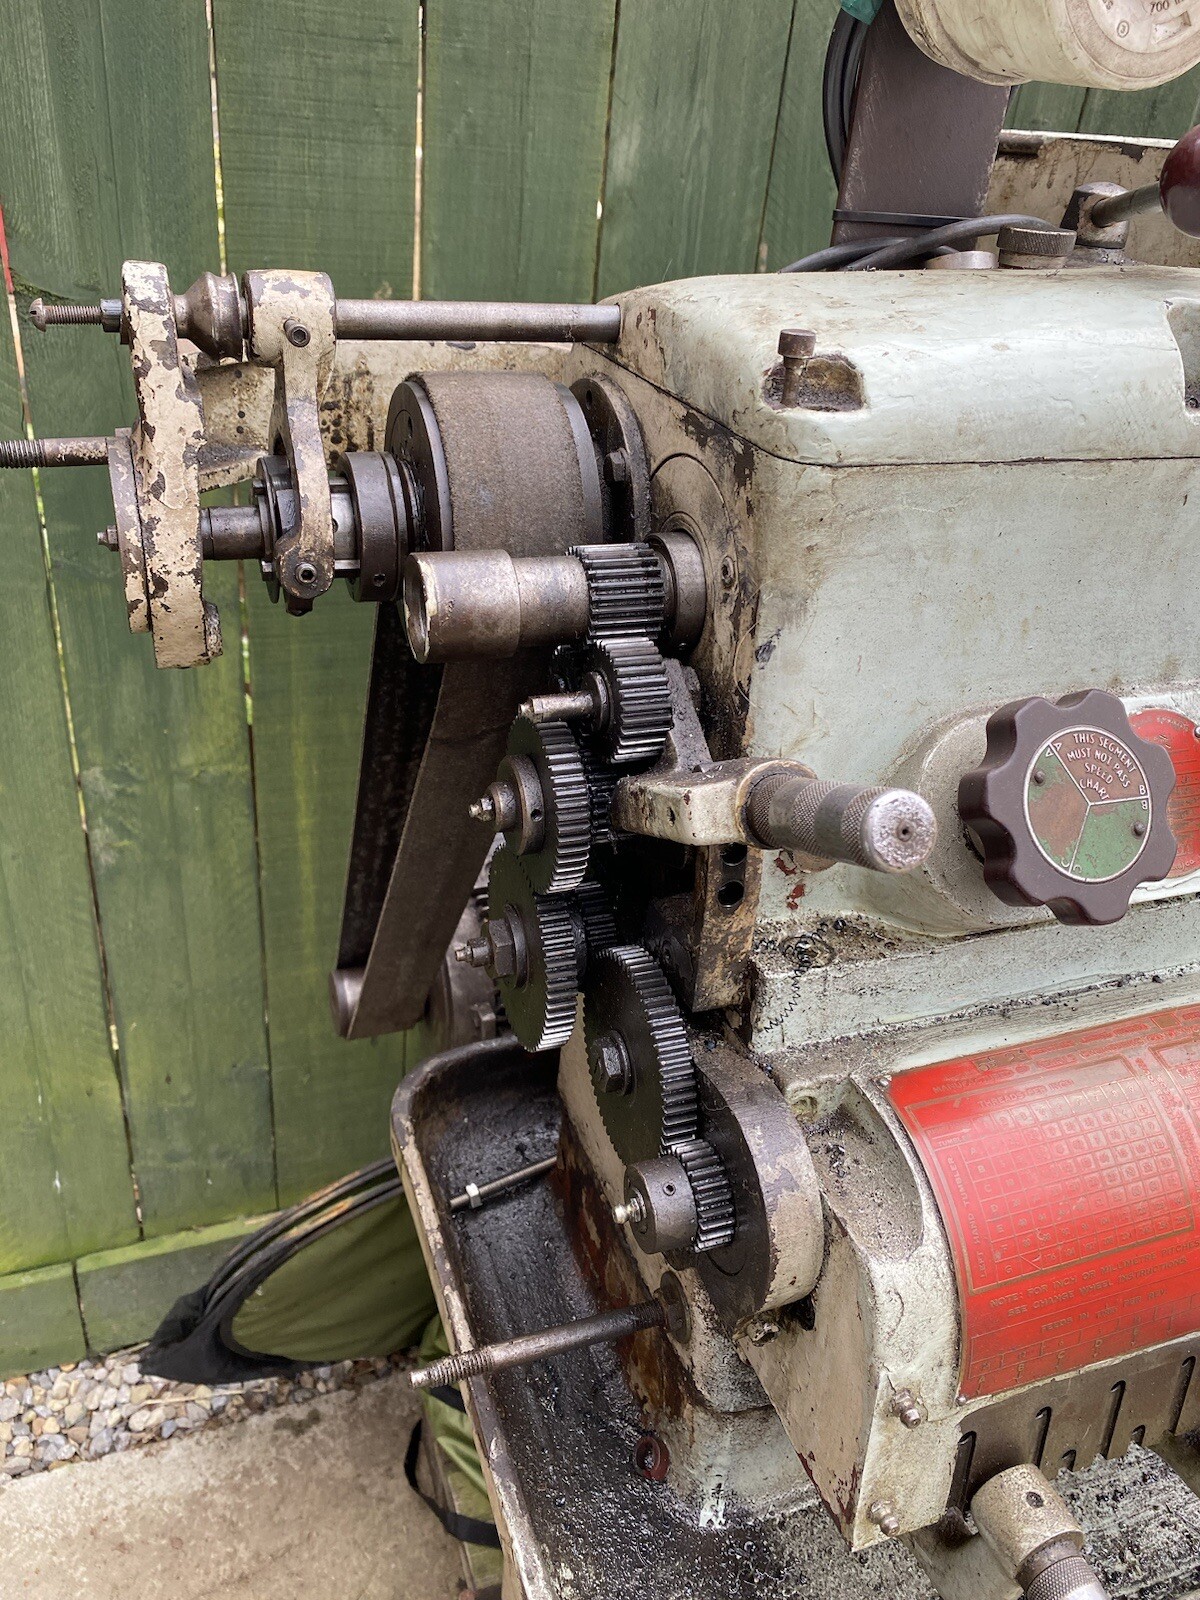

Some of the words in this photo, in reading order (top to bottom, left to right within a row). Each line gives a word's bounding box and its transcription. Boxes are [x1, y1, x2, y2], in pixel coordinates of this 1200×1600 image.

[1053, 742, 1063, 751] A
[1073, 733, 1095, 745] THIS
[1099, 736, 1137, 773] SEGMENT
[1066, 747, 1091, 762] MUST
[1094, 751, 1112, 766] NOT
[1113, 762, 1131, 788] PASS
[1084, 762, 1113, 784] SPEED
[1079, 778, 1110, 800] CHART
[1139, 784, 1146, 795] B
[979, 1092, 1025, 1108] THREADS
[947, 1157, 970, 1208] TUMBLER
[967, 1212, 981, 1245] HAND
[1027, 1284, 1048, 1296] FOR
[1053, 1276, 1077, 1288] INCH
[1081, 1269, 1096, 1280] OR
[1161, 1239, 1200, 1257] PITCHES
[1008, 1305, 1028, 1317] SEE
[1032, 1290, 1075, 1309] CHANGE
[1079, 1279, 1113, 1295] WHEEL
